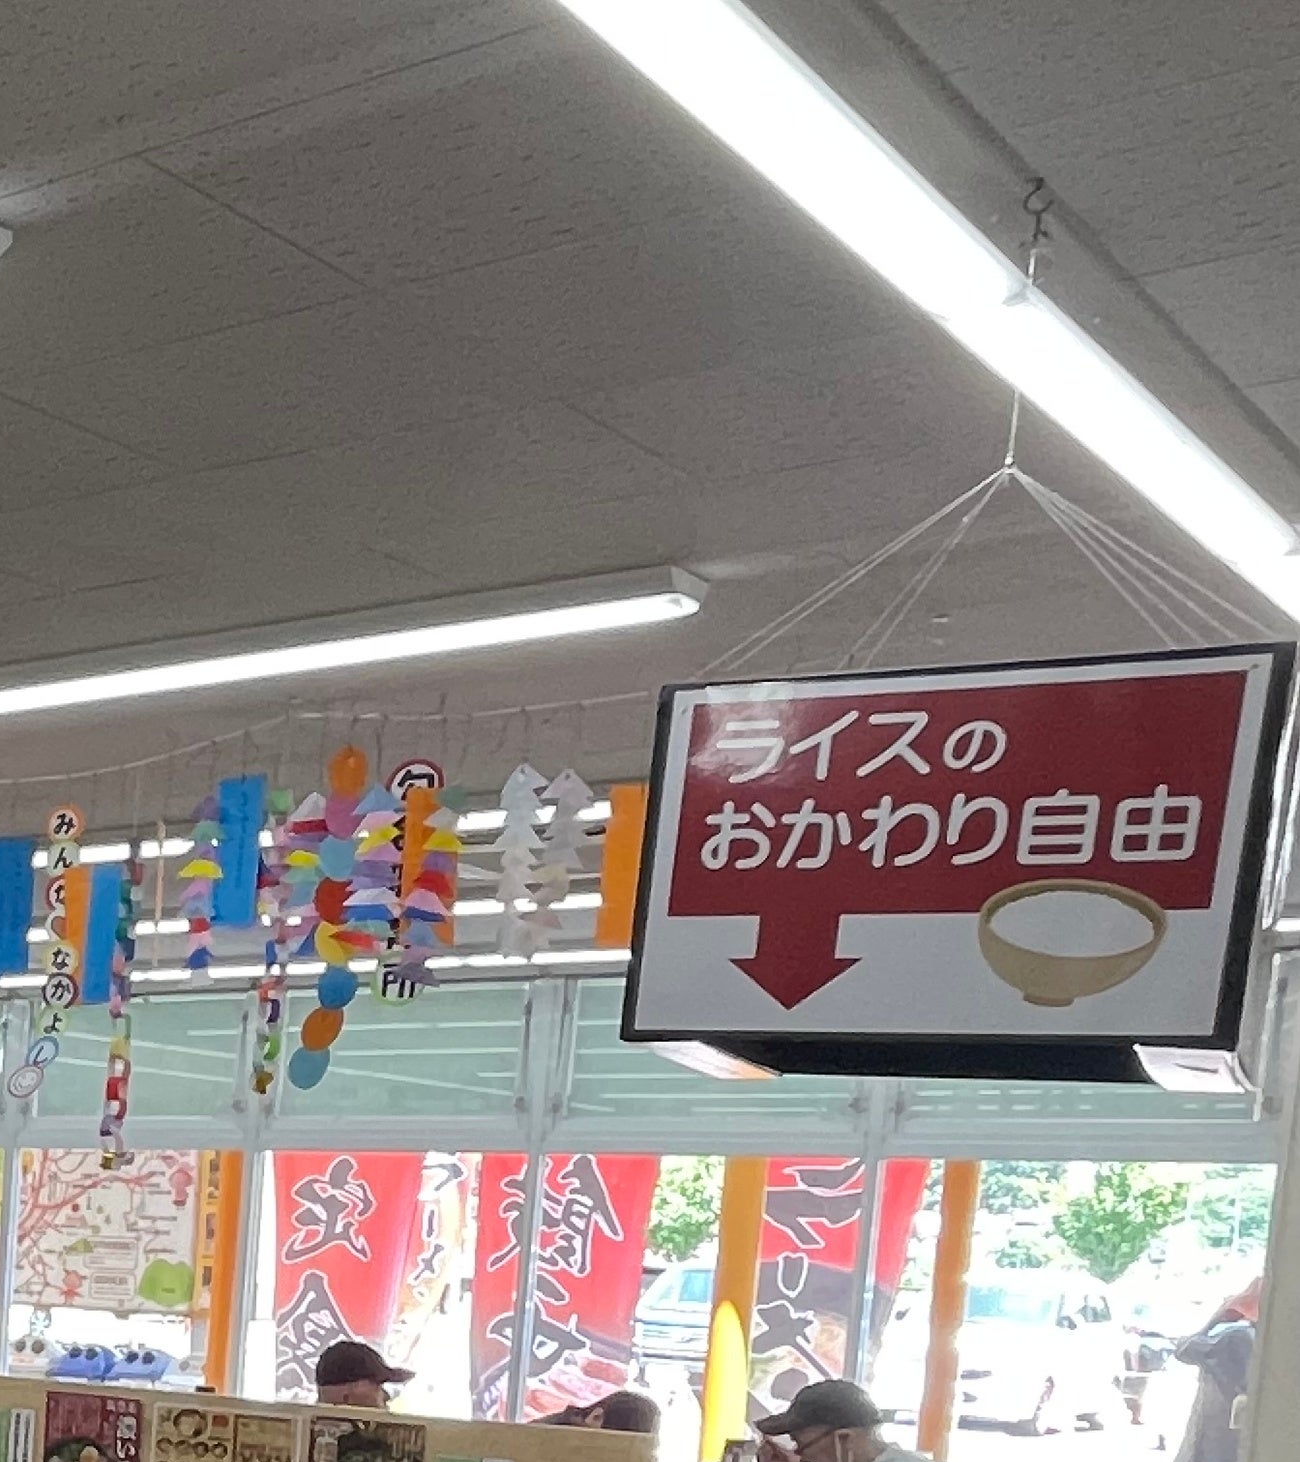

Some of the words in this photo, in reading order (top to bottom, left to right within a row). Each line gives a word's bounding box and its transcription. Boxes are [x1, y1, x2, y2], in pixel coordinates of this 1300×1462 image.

[716, 709, 1007, 784] ライスの
[700, 784, 1202, 872] おかわり自由
